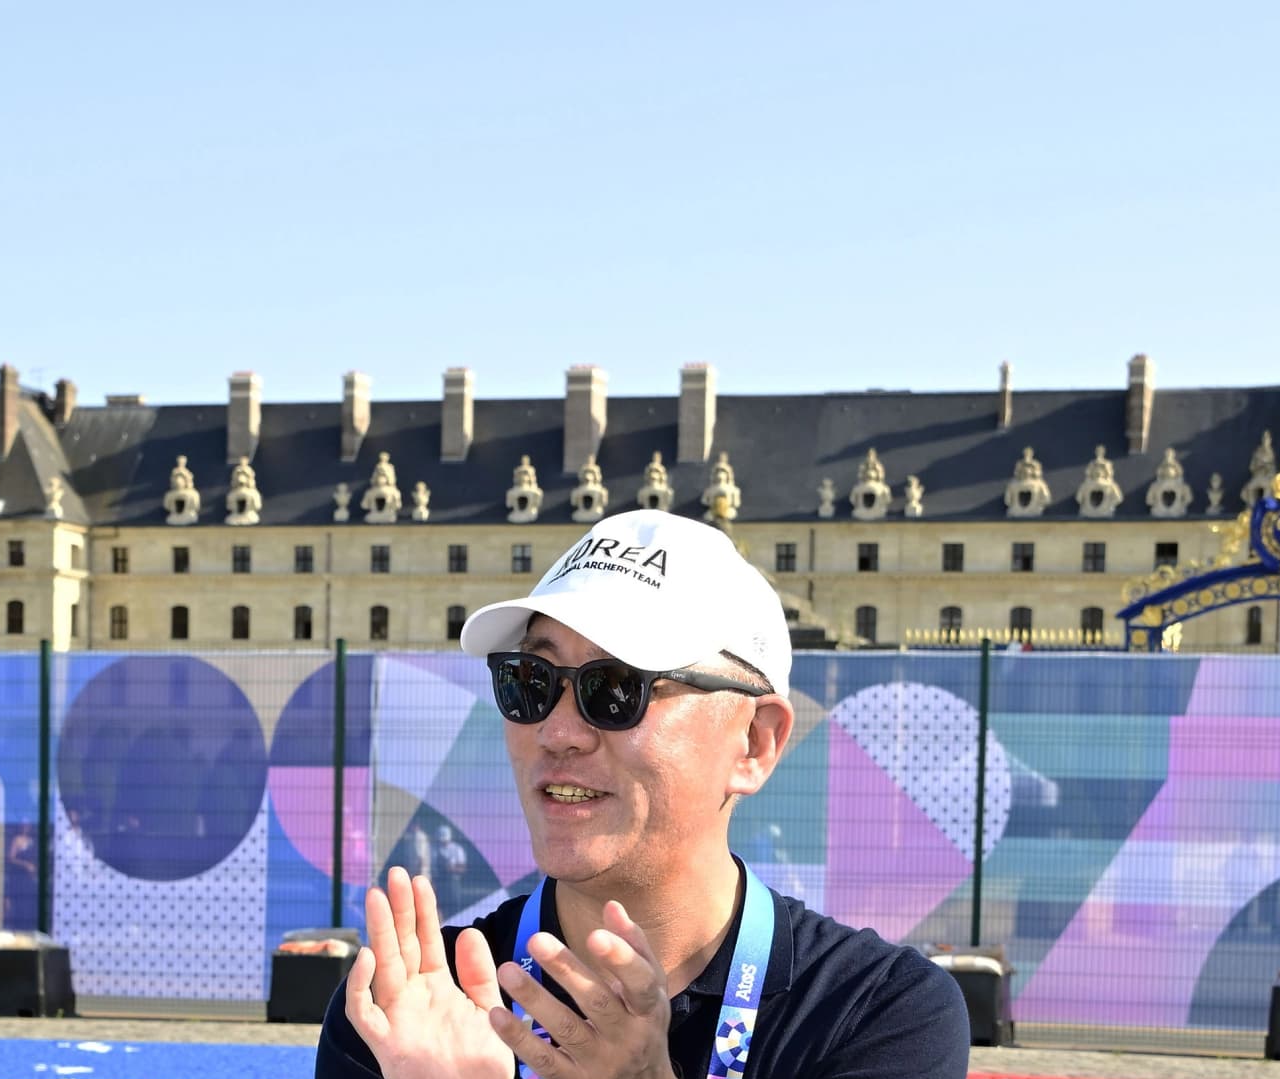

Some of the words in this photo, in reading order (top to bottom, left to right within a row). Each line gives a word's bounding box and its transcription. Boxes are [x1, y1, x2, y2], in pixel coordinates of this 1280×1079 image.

[583, 561, 631, 575] ARCHERY
[632, 570, 661, 589] TEAM
[735, 962, 757, 1002] Atos
